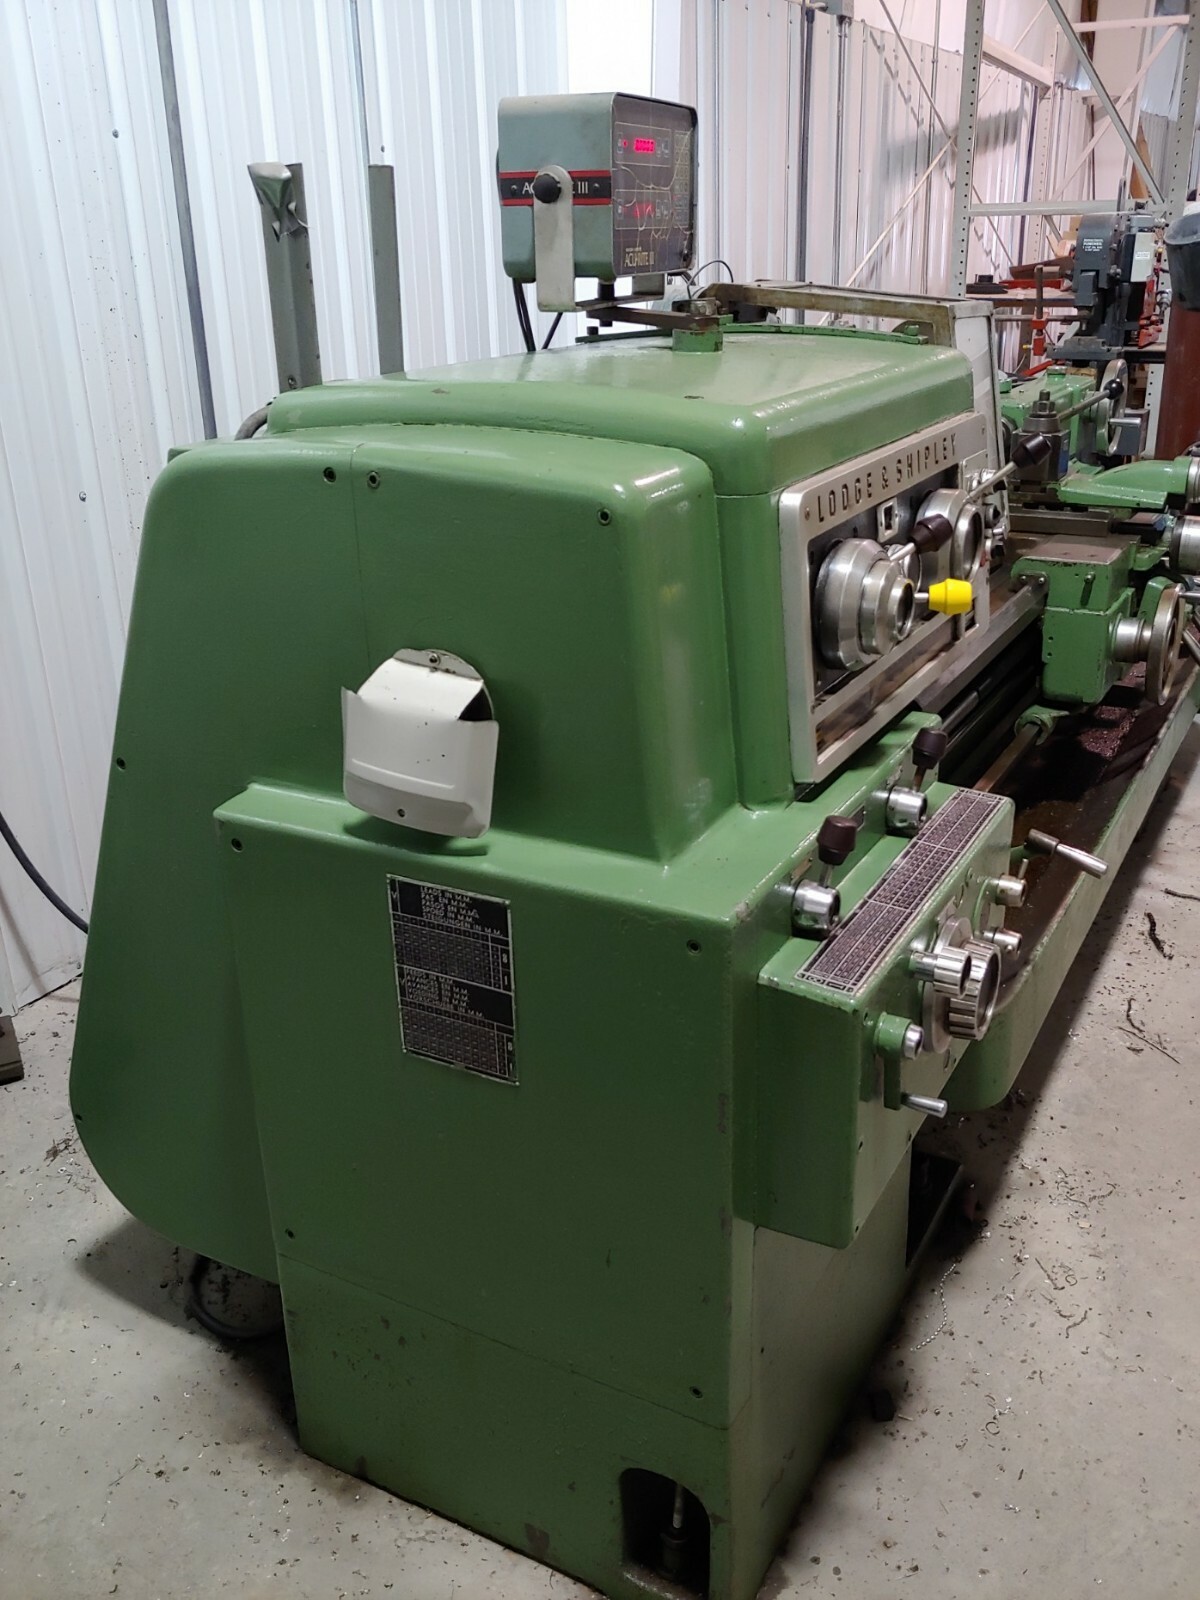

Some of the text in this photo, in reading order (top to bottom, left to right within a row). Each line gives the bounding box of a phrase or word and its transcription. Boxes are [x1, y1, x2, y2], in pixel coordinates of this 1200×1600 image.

[577, 181, 589, 194] III
[817, 433, 957, 523] LODGE & SHIPLEY
